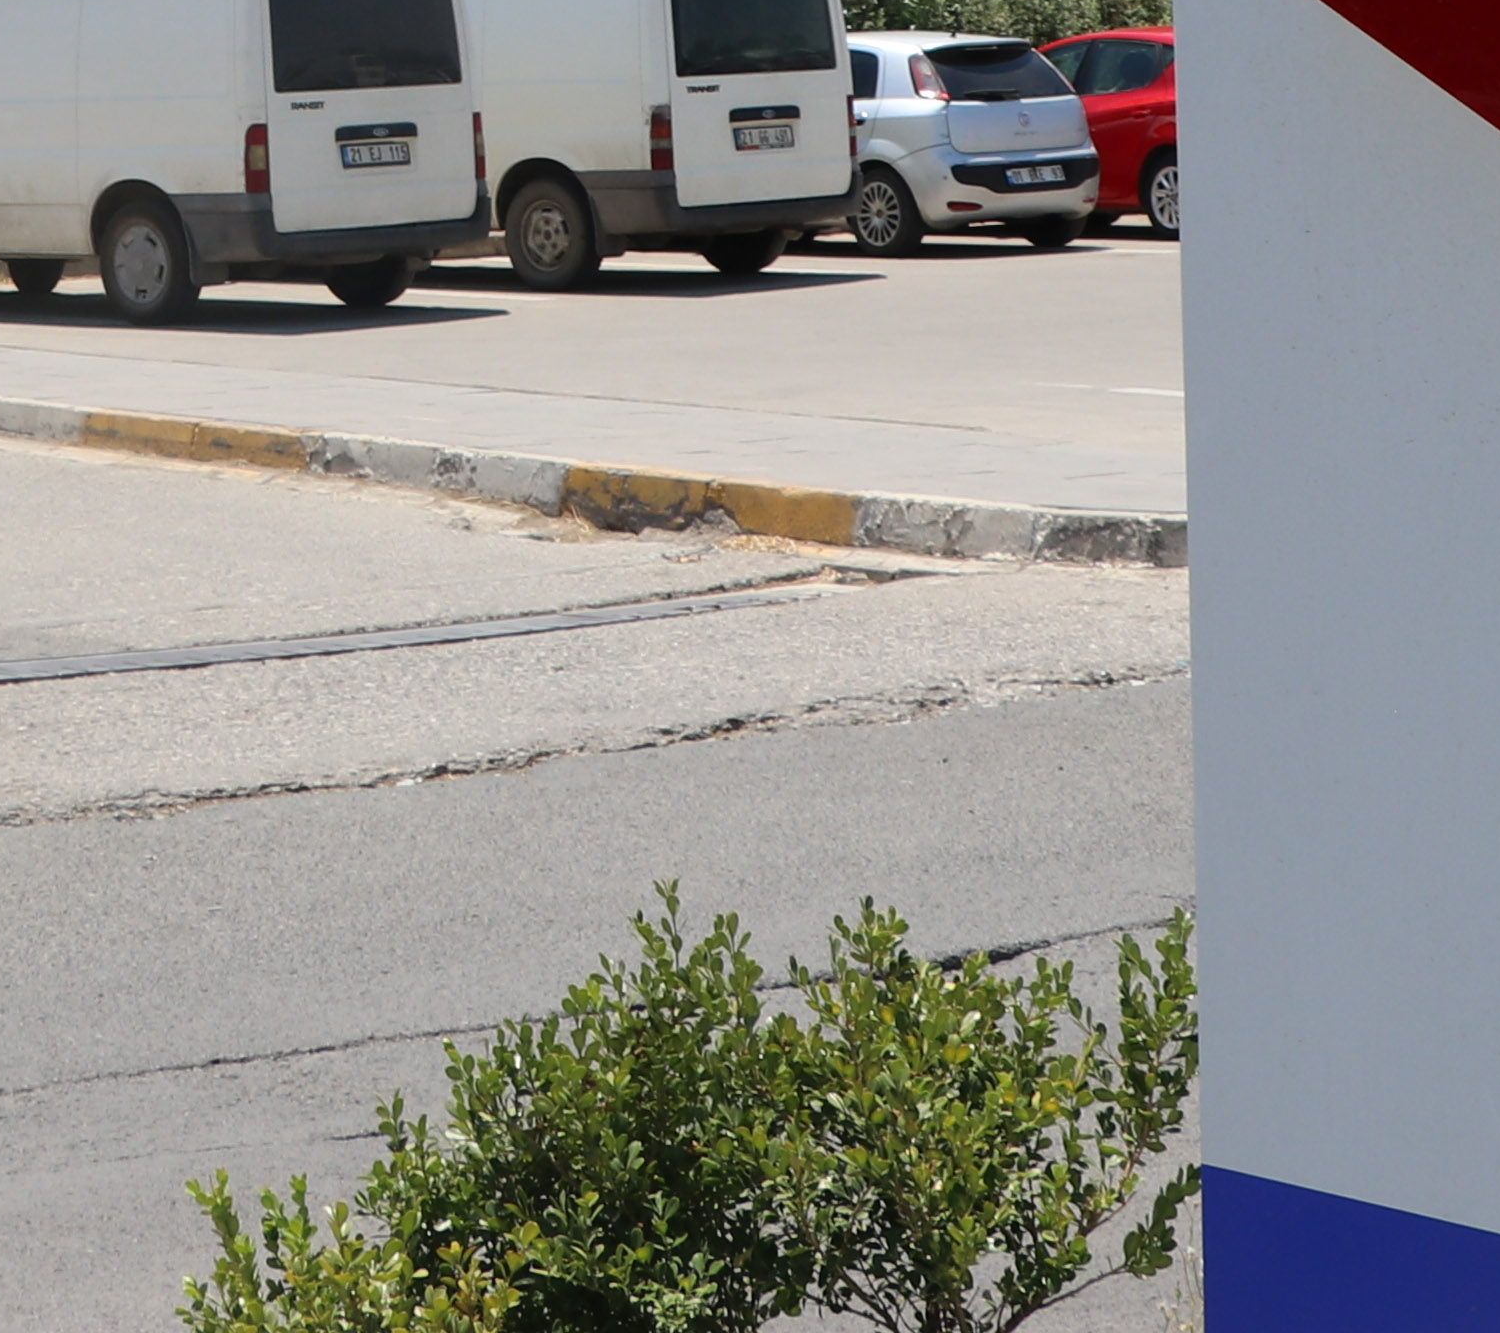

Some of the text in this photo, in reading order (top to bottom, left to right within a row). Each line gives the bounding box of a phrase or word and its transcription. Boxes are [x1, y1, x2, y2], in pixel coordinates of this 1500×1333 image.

[350, 145, 409, 163] 21 EJ 115
